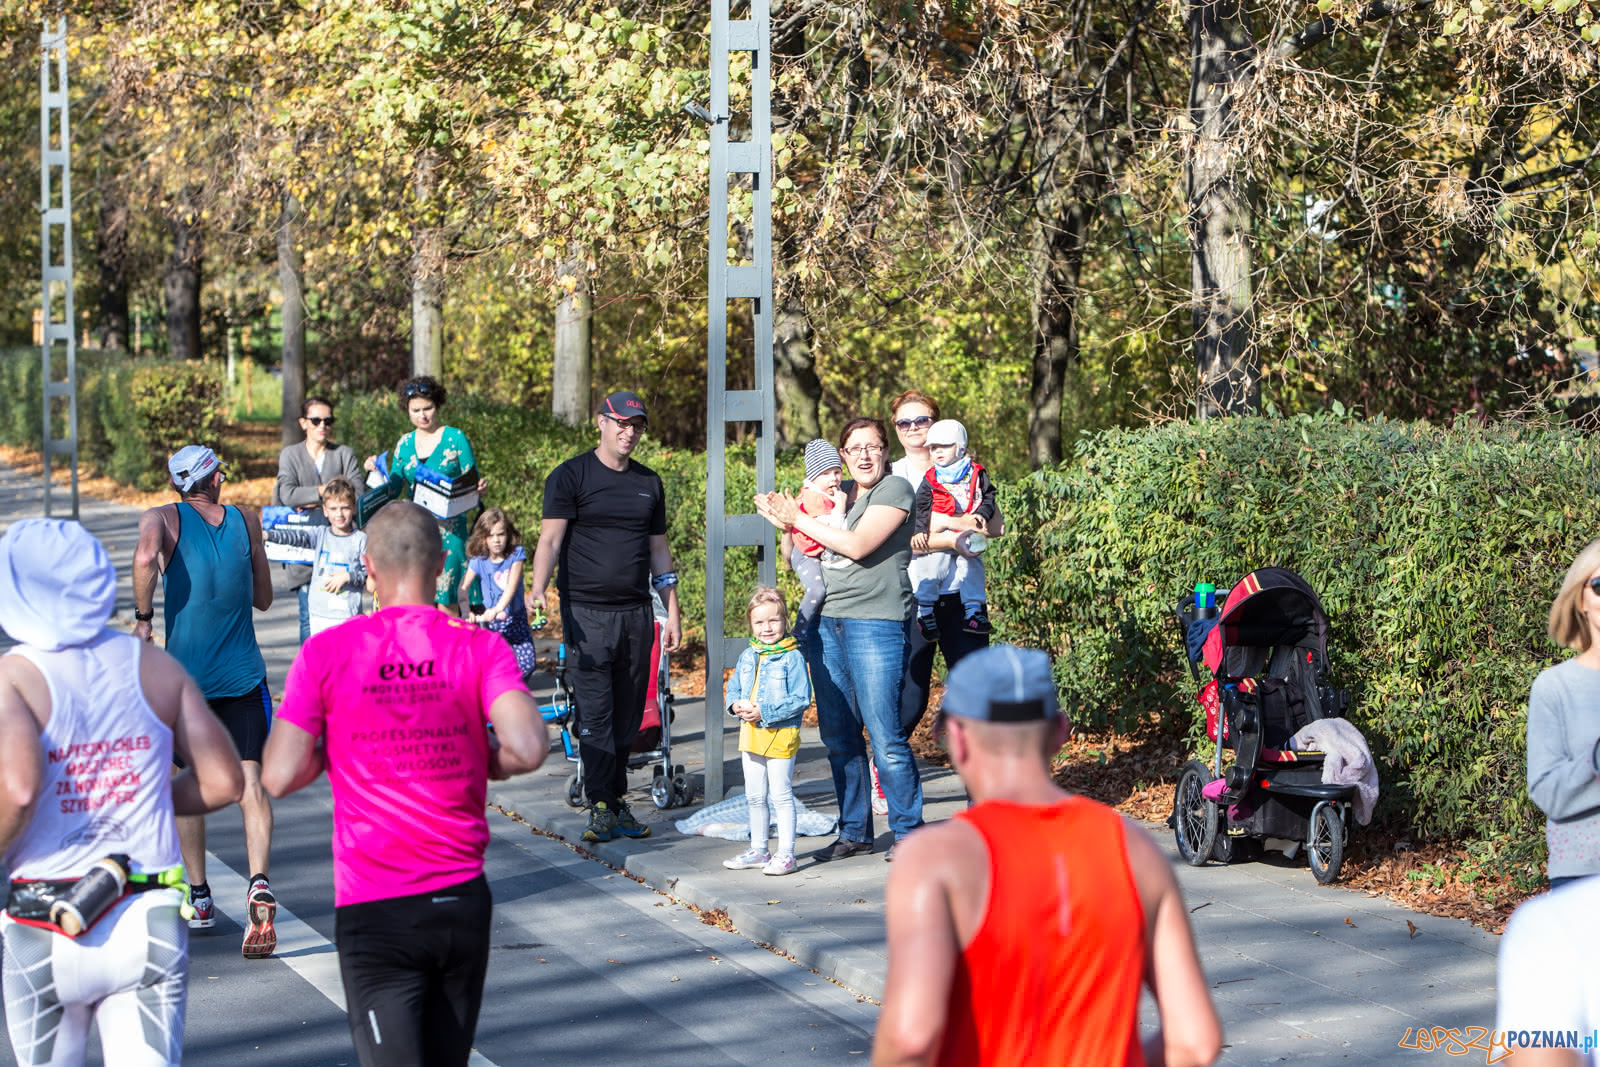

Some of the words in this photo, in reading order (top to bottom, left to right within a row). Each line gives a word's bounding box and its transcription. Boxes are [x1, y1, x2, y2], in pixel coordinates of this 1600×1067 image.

[379, 660, 436, 680] eva
[362, 680, 455, 694] PROFESSIONAL
[352, 723, 469, 741] PROFESJONALNE
[111, 735, 152, 752] CHLEB
[56, 781, 72, 796] ZA
